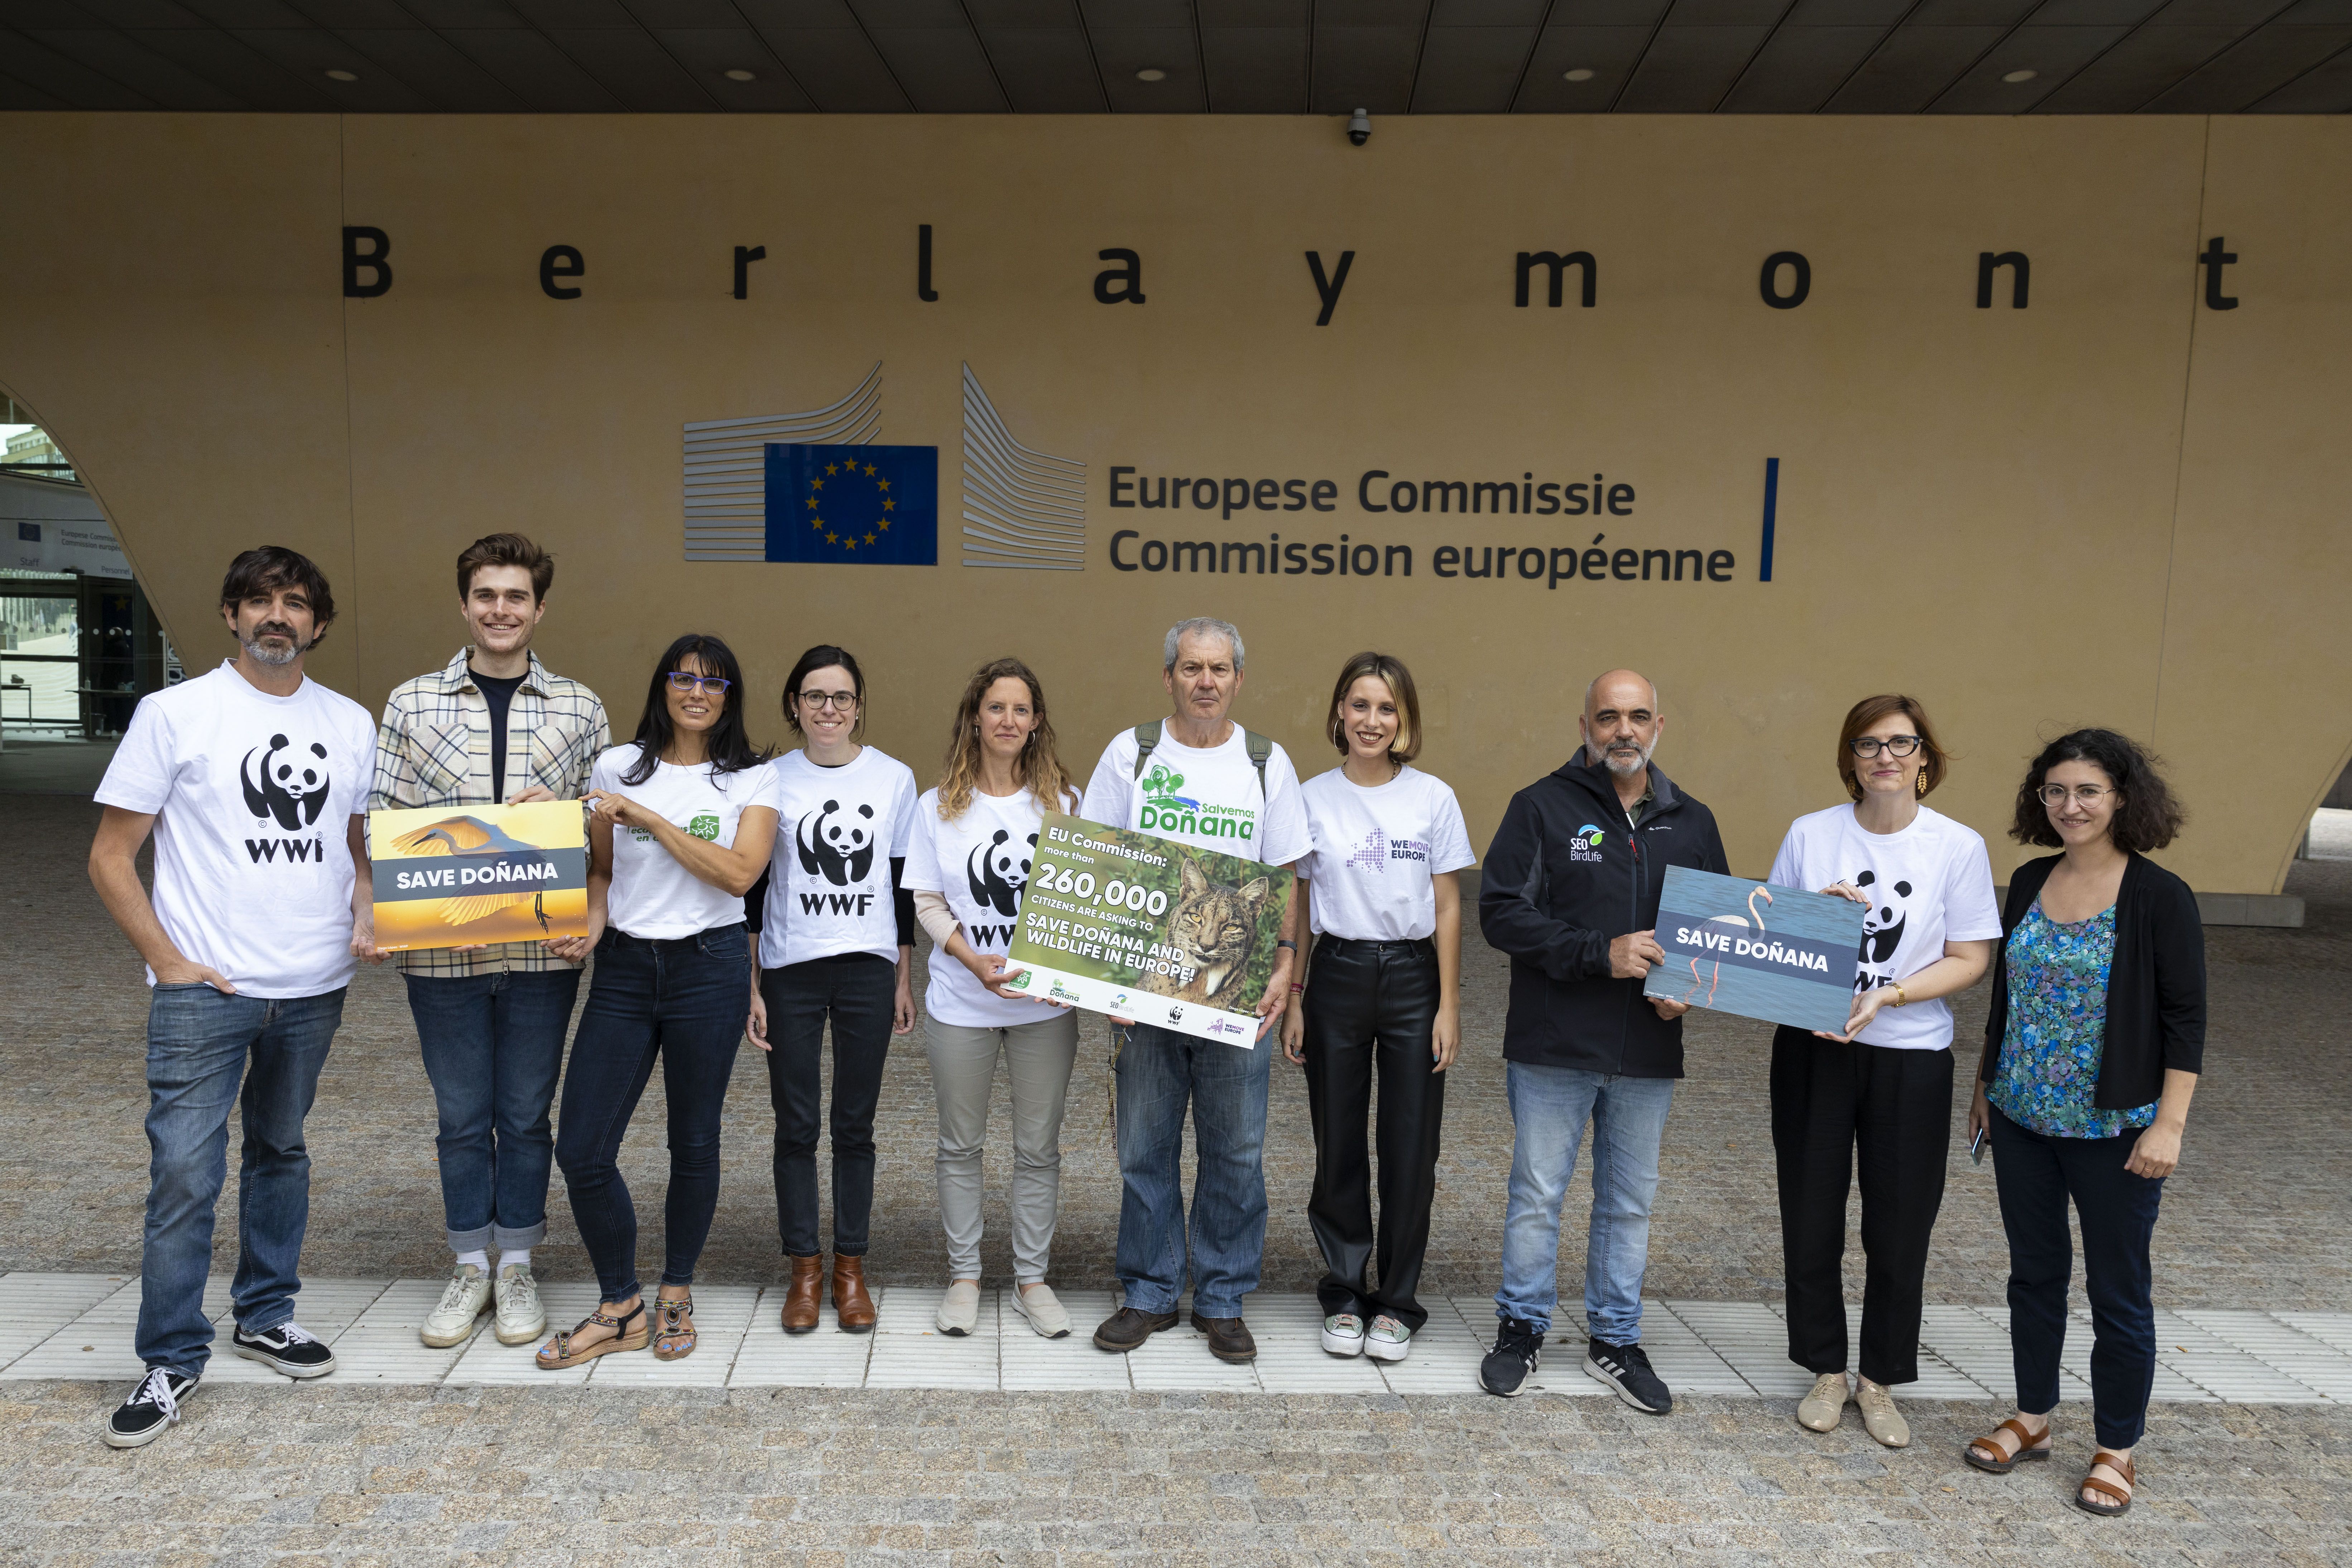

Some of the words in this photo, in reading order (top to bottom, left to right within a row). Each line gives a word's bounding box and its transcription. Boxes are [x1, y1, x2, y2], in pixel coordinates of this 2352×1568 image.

[1109, 466, 1338, 520] Europese
[1358, 470, 1636, 516] Commissie
[61, 529, 88, 539] Europese
[90, 533, 118, 542] Commiss
[62, 538, 97, 549] Commission
[20, 557, 40, 566] Staff
[1109, 530, 1412, 576] Commission
[1433, 533, 1735, 589] européenne
[101, 566, 130, 575] Personnel
[1202, 803, 1254, 819] Salvemos
[1139, 806, 1254, 840] Doñana
[1048, 826, 1070, 843] EU
[1071, 833, 1168, 867] Commission:
[1571, 838, 1588, 850] SEO
[1044, 846, 1069, 858] more
[1072, 851, 1095, 864] than
[1391, 850, 1426, 862] EUROPE
[1571, 850, 1602, 862] BirdLife
[397, 869, 455, 889] SAVE
[461, 861, 558, 885] DOÑANA
[1035, 862, 1168, 916] 260,000
[799, 893, 874, 916] WWF
[1031, 895, 1075, 913] CITIZENS
[1076, 905, 1098, 918] ARE
[1098, 911, 1137, 927] ASKING
[1139, 921, 1153, 931] TO
[1025, 912, 1070, 934] SAVE
[1071, 923, 1144, 954] DOÑANA
[1147, 943, 1185, 963] AND
[1027, 927, 1102, 959] WILDLIFE
[1103, 948, 1123, 966] IN
[1124, 952, 1196, 982] EUROPE!
[1676, 927, 1731, 953] SAVE
[1734, 939, 1828, 972] DOÑANA
[1050, 989, 1079, 1002] Doñana
[1118, 1004, 1134, 1013] BirdLife
